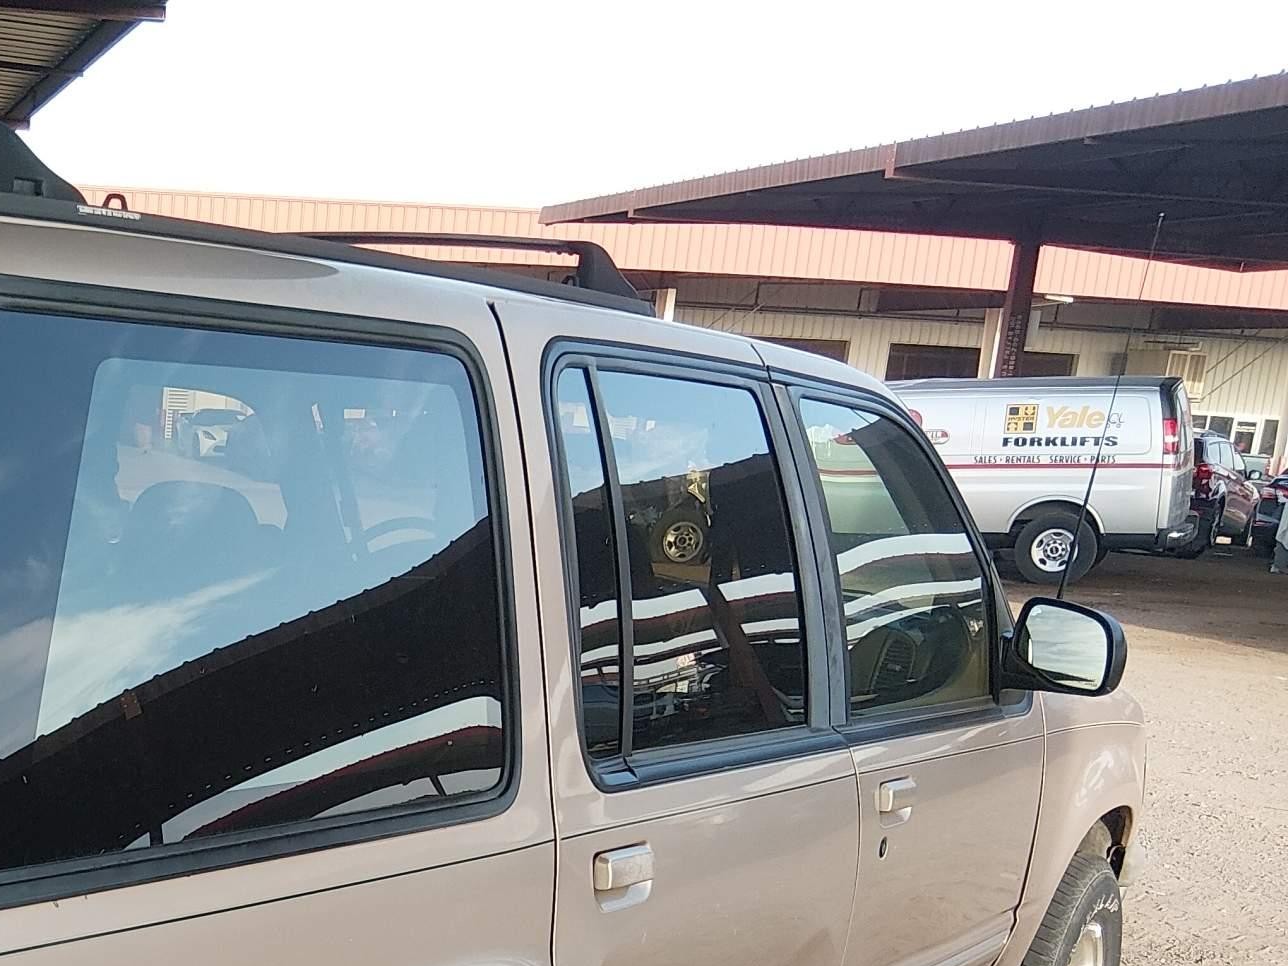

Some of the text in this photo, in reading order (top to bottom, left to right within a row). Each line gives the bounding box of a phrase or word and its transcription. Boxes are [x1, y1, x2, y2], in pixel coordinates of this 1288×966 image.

[1046, 405, 1107, 429] Yale
[1002, 436, 1119, 448] FORKLIFTS
[974, 455, 997, 464] SALES
[1005, 455, 1041, 464] RENTALS
[1049, 455, 1081, 464] SERVICE
